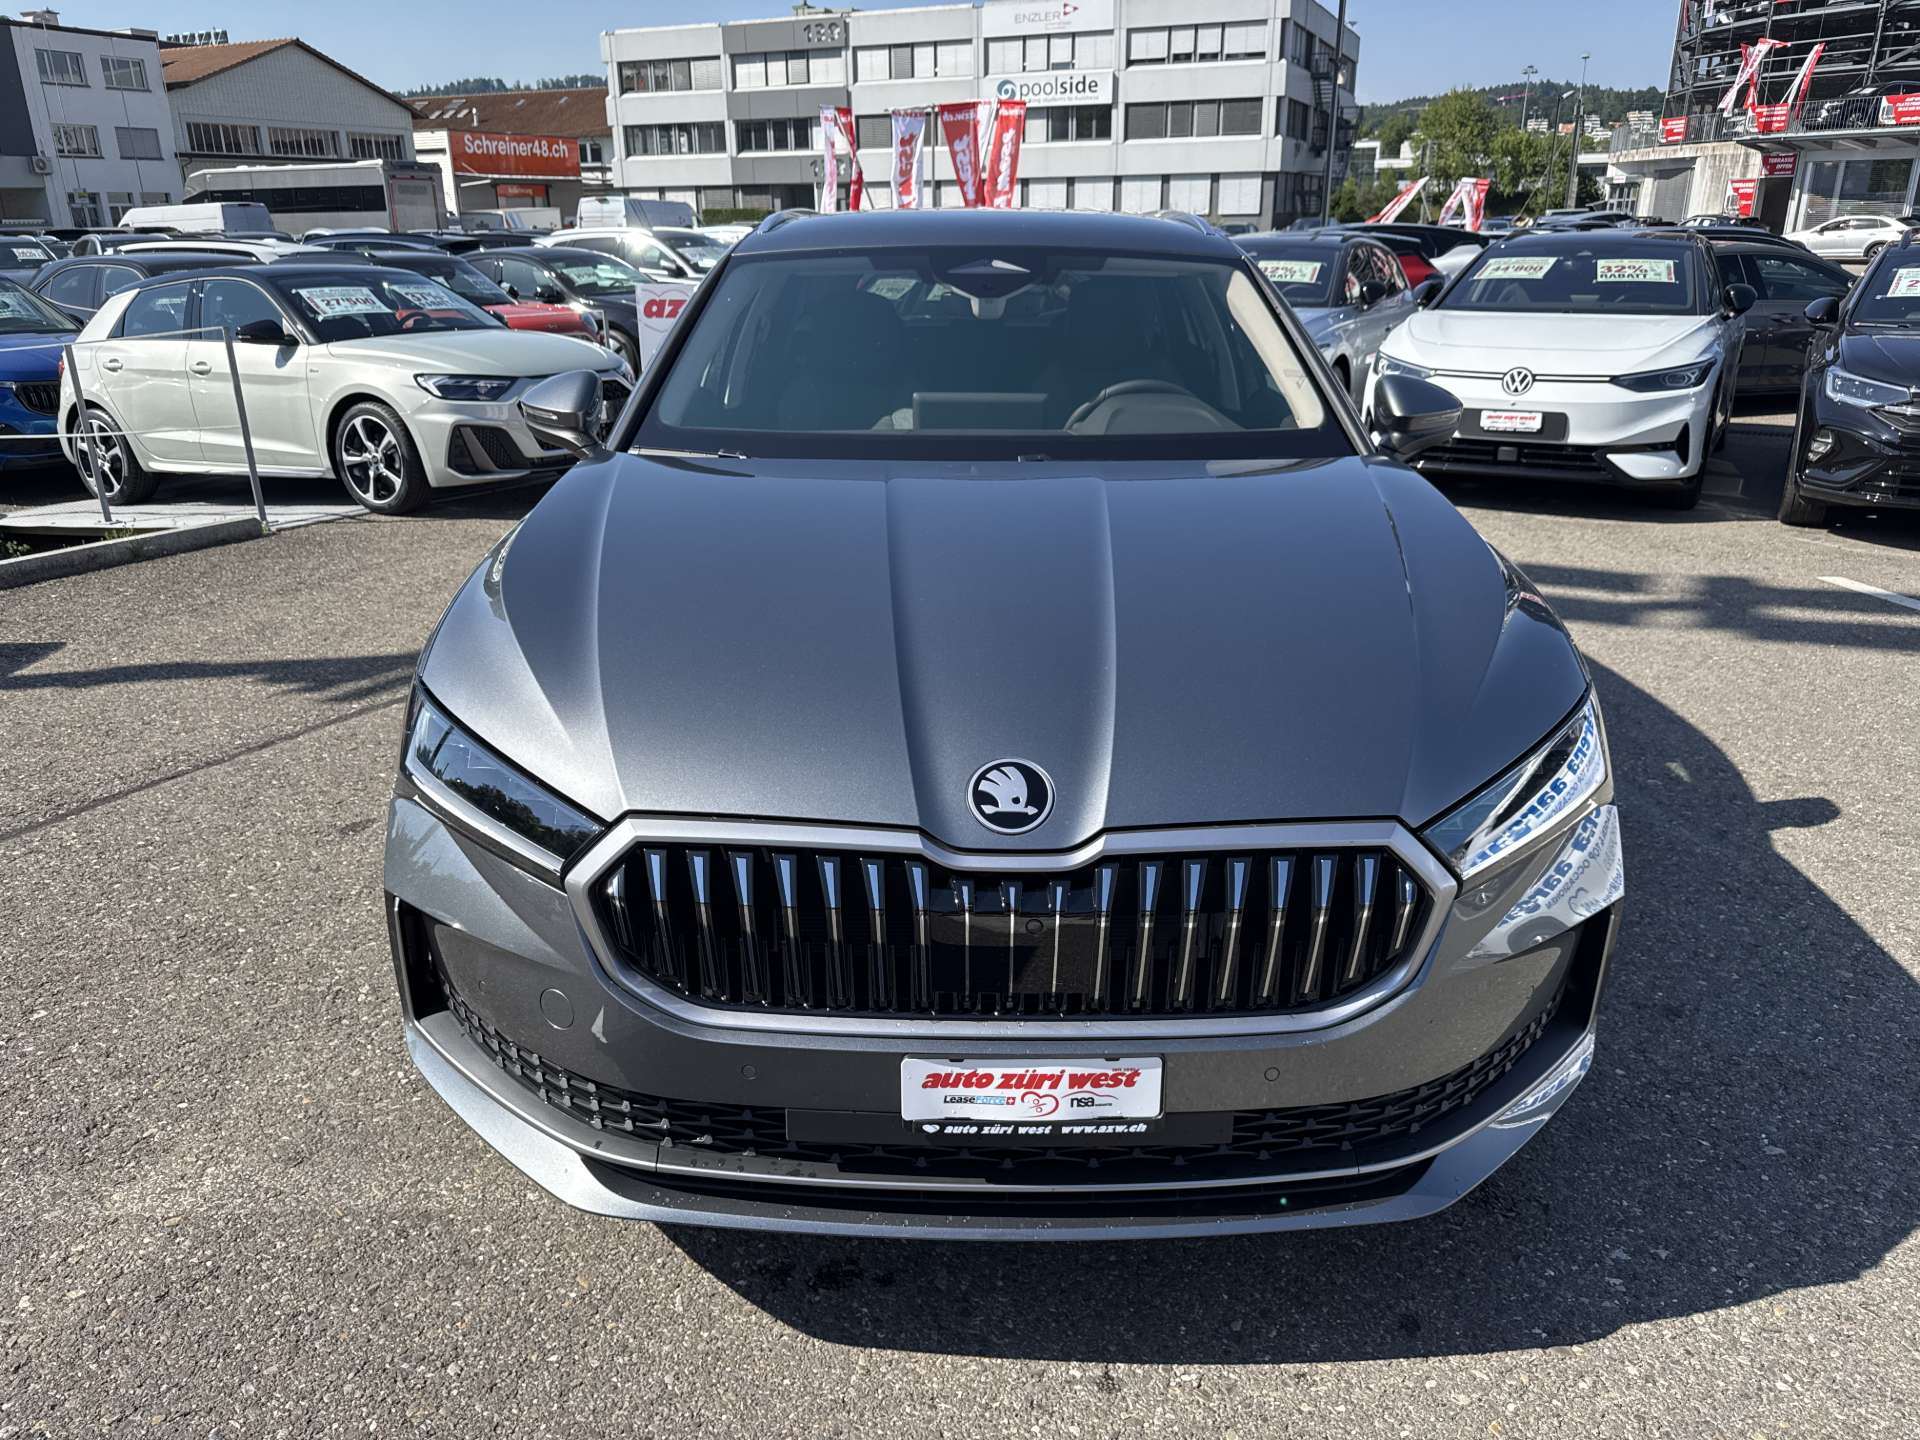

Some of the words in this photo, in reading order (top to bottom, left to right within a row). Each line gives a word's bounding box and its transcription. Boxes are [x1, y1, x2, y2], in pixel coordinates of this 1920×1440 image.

[1014, 11, 1062, 24] ENZLER
[1019, 74, 1099, 101] poolside
[464, 133, 569, 158] Schreiner48.ch
[1600, 264, 1649, 274] 32%
[922, 1069, 995, 1089] auto
[995, 1069, 1066, 1089] züri
[1068, 1070, 1141, 1089] west
[943, 1095, 1005, 1105] LeaseForce
[1070, 1097, 1095, 1108] nsa
[943, 1124, 979, 1134] auto
[981, 1123, 1015, 1134] züri
[1017, 1125, 1052, 1135] west
